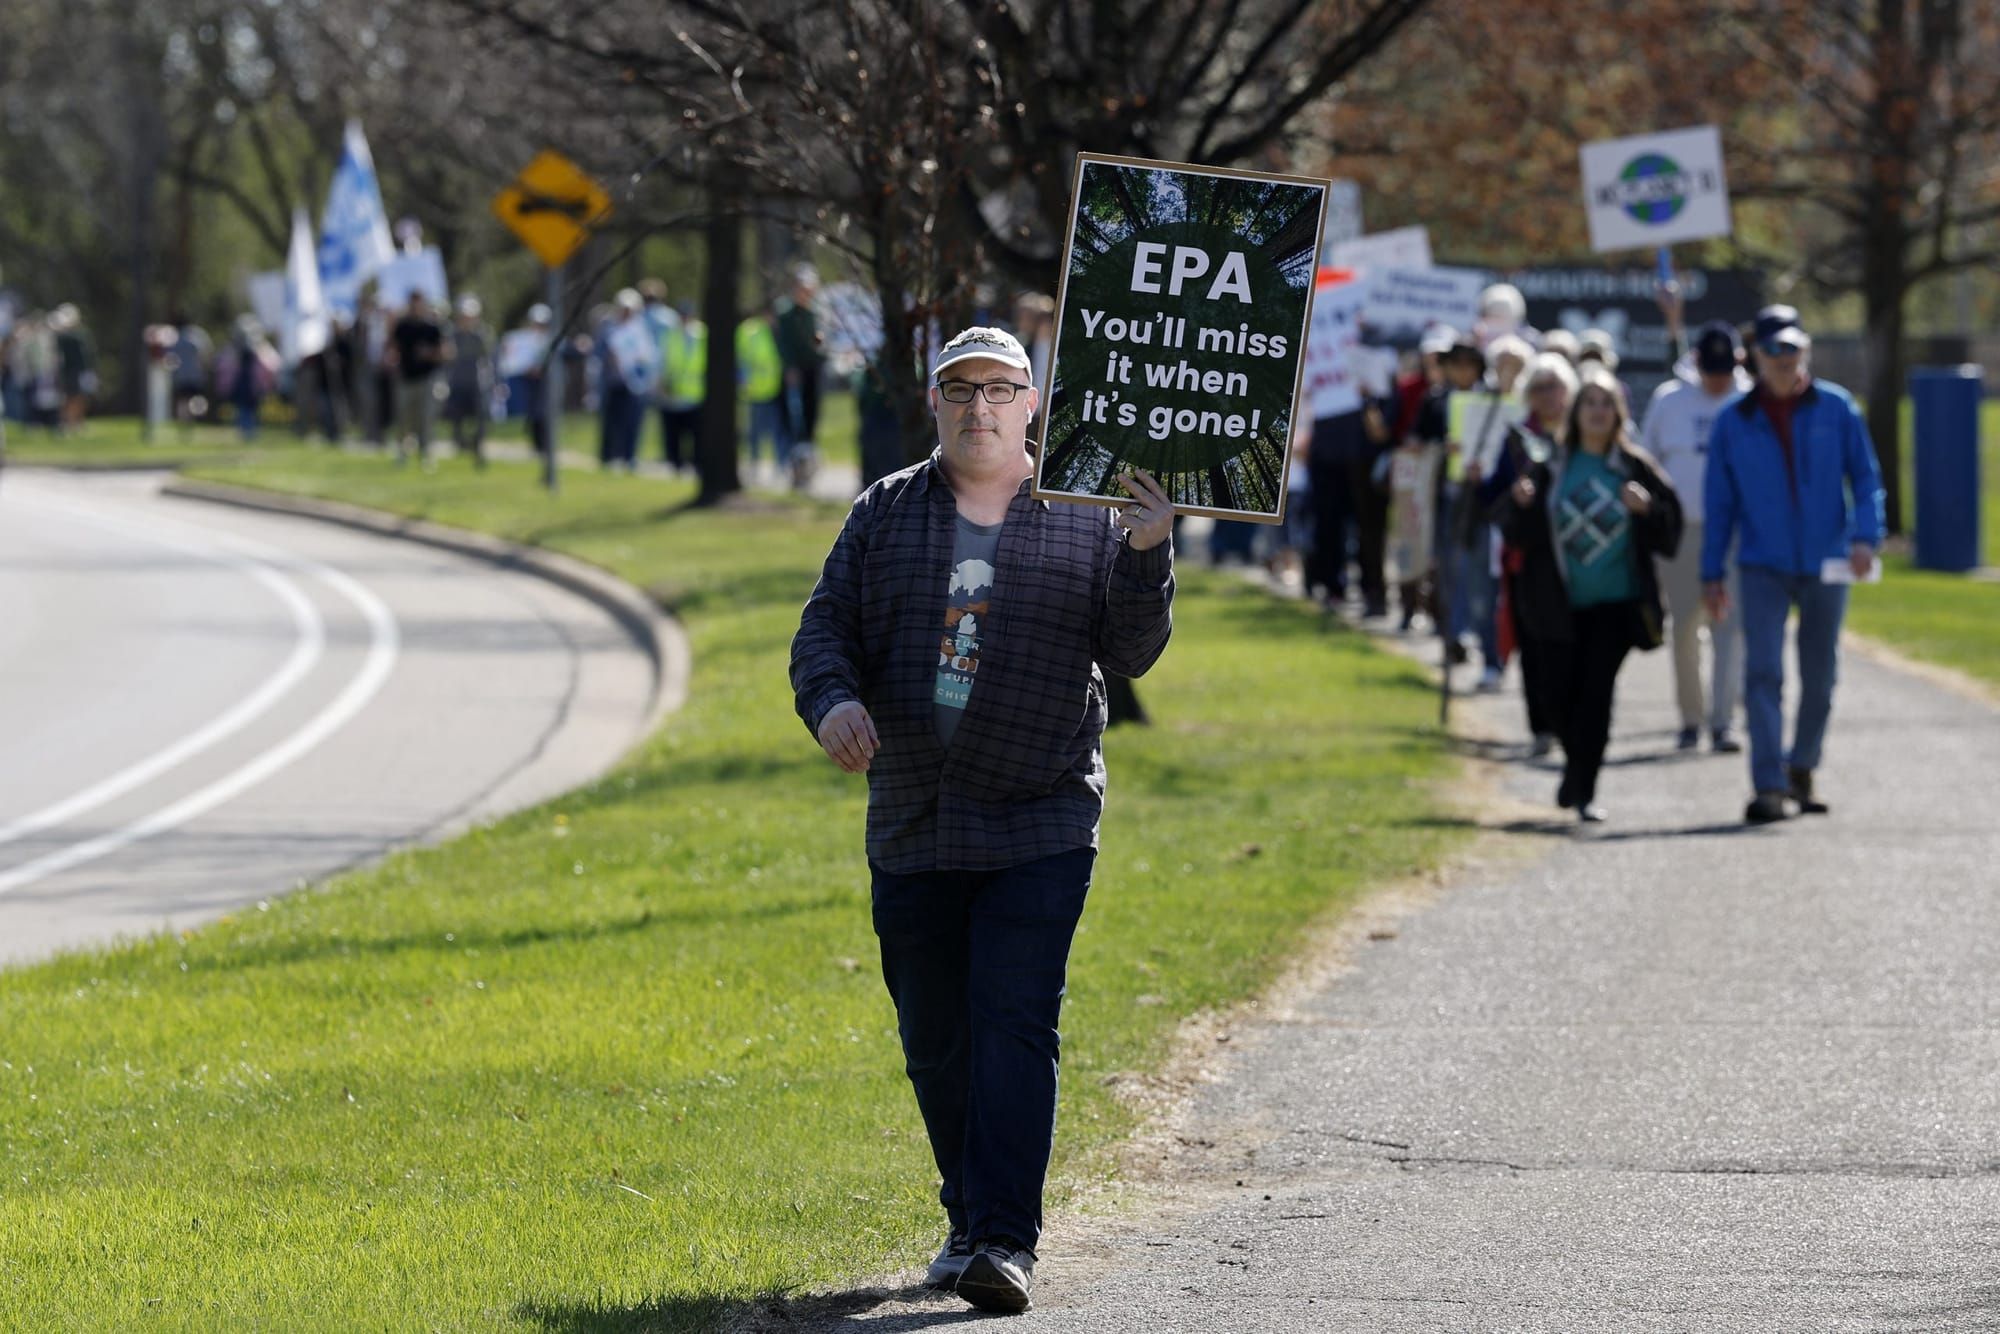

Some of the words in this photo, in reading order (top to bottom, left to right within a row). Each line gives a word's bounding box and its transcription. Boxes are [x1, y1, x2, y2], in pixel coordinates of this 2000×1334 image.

[1130, 241, 1253, 304] EPA
[1080, 308, 1186, 348] You’ll
[1197, 322, 1288, 359] miss
[1105, 350, 1133, 384] it
[1144, 360, 1248, 397] when
[1081, 390, 1137, 426] it’s
[1148, 405, 1261, 440] gone!
[944, 638, 982, 652] CTUR
